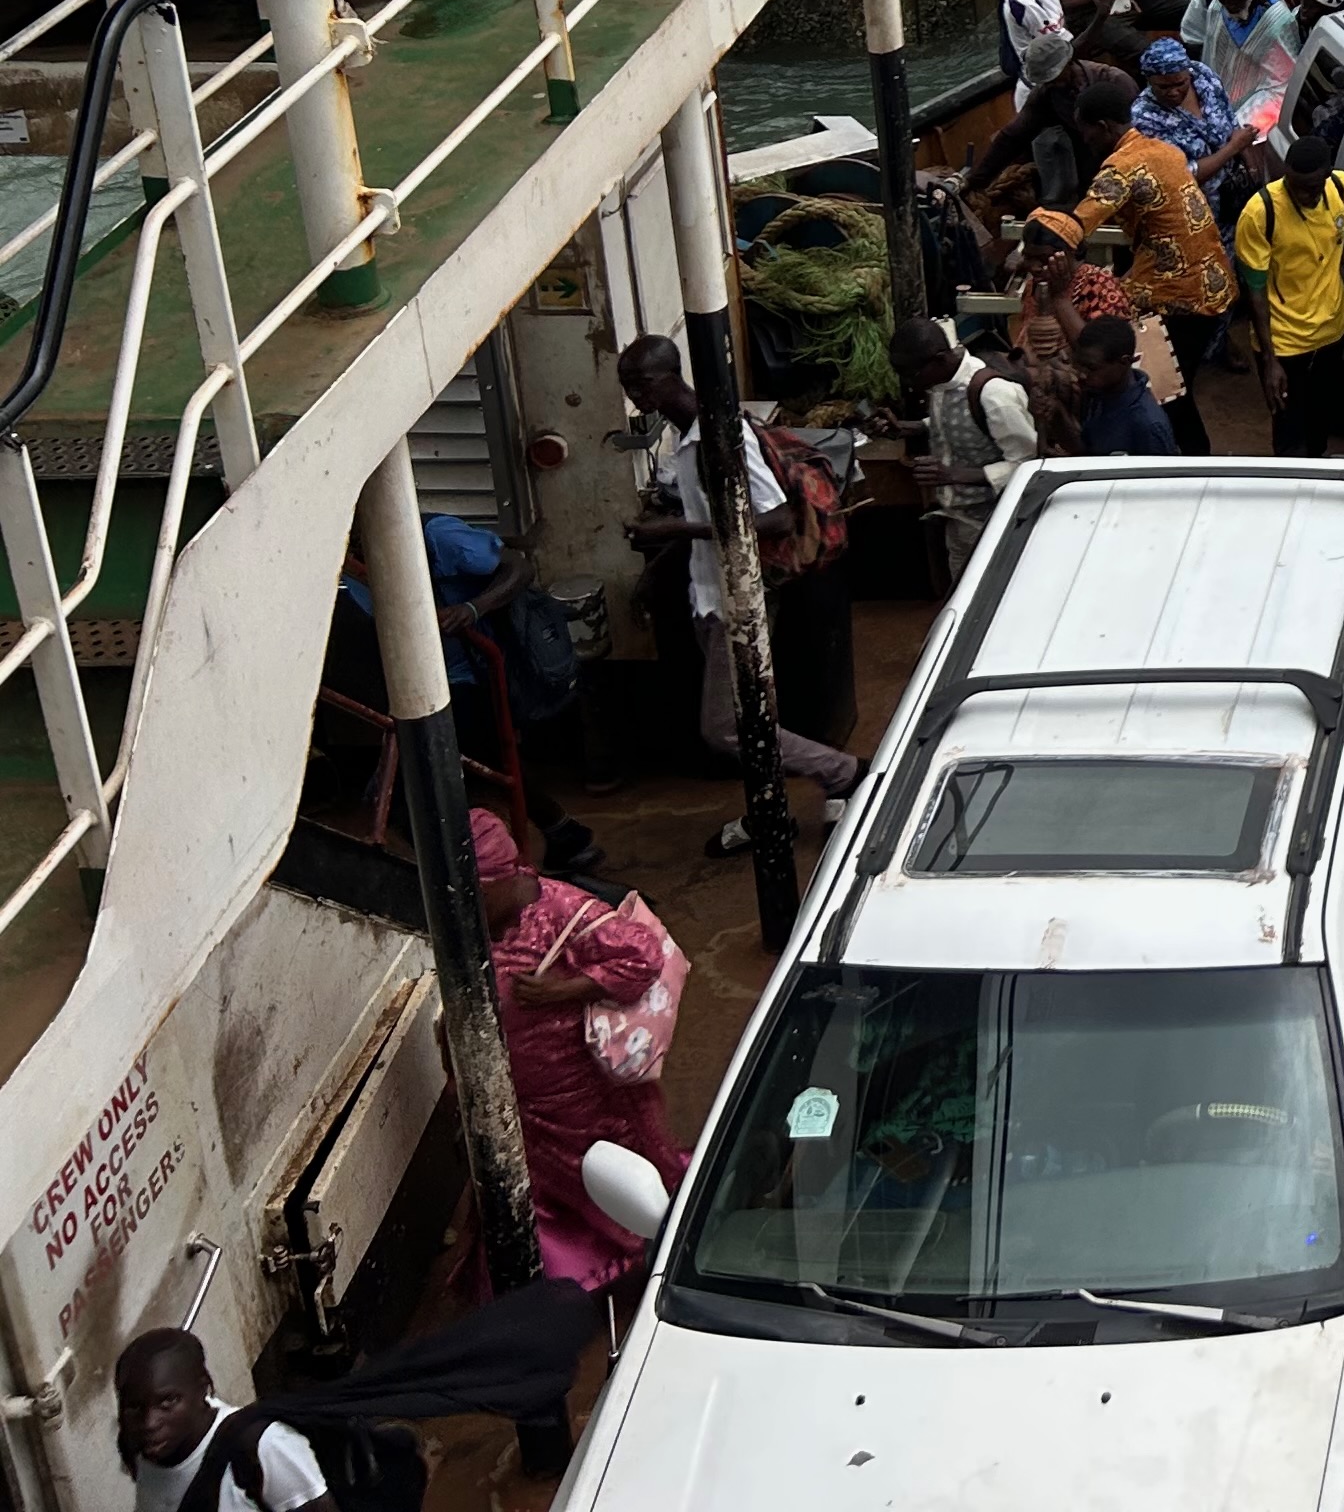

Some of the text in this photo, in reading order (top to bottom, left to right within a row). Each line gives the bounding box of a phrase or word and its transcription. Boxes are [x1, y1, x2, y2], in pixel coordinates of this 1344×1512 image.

[32, 1051, 151, 1236] CREW ONLY
[45, 1091, 161, 1271] NO ACCESS
[90, 1171, 131, 1248] FOR
